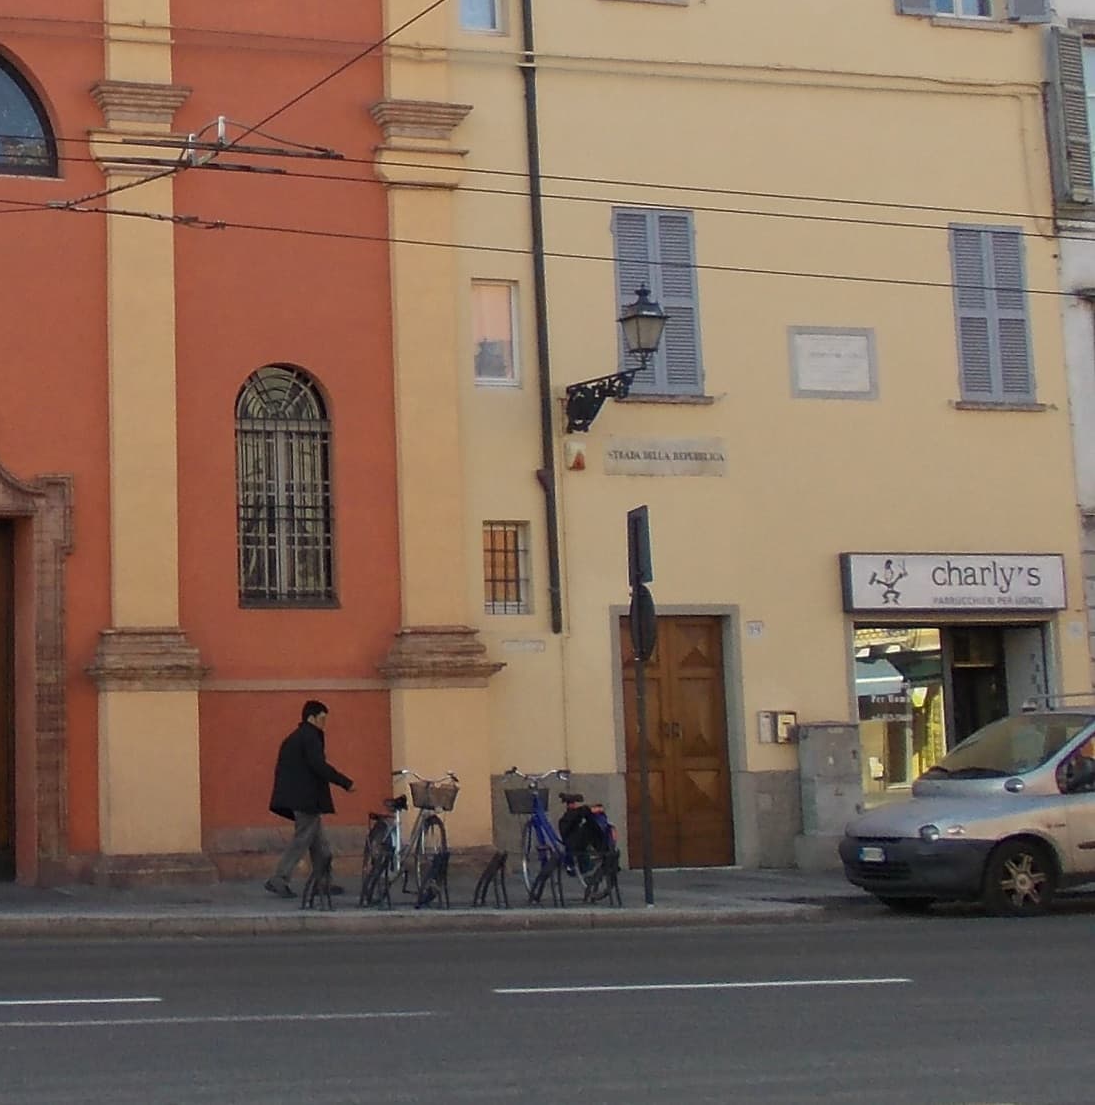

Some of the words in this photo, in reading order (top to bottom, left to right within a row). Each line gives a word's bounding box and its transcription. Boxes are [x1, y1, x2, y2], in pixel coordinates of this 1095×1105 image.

[608, 450, 641, 460] STRADA
[642, 450, 671, 461] DELLA
[673, 451, 724, 462] REPUBBLICA
[931, 560, 1041, 594] charly's
[997, 596, 1013, 605] PER
[1015, 596, 1044, 606] UOMO
